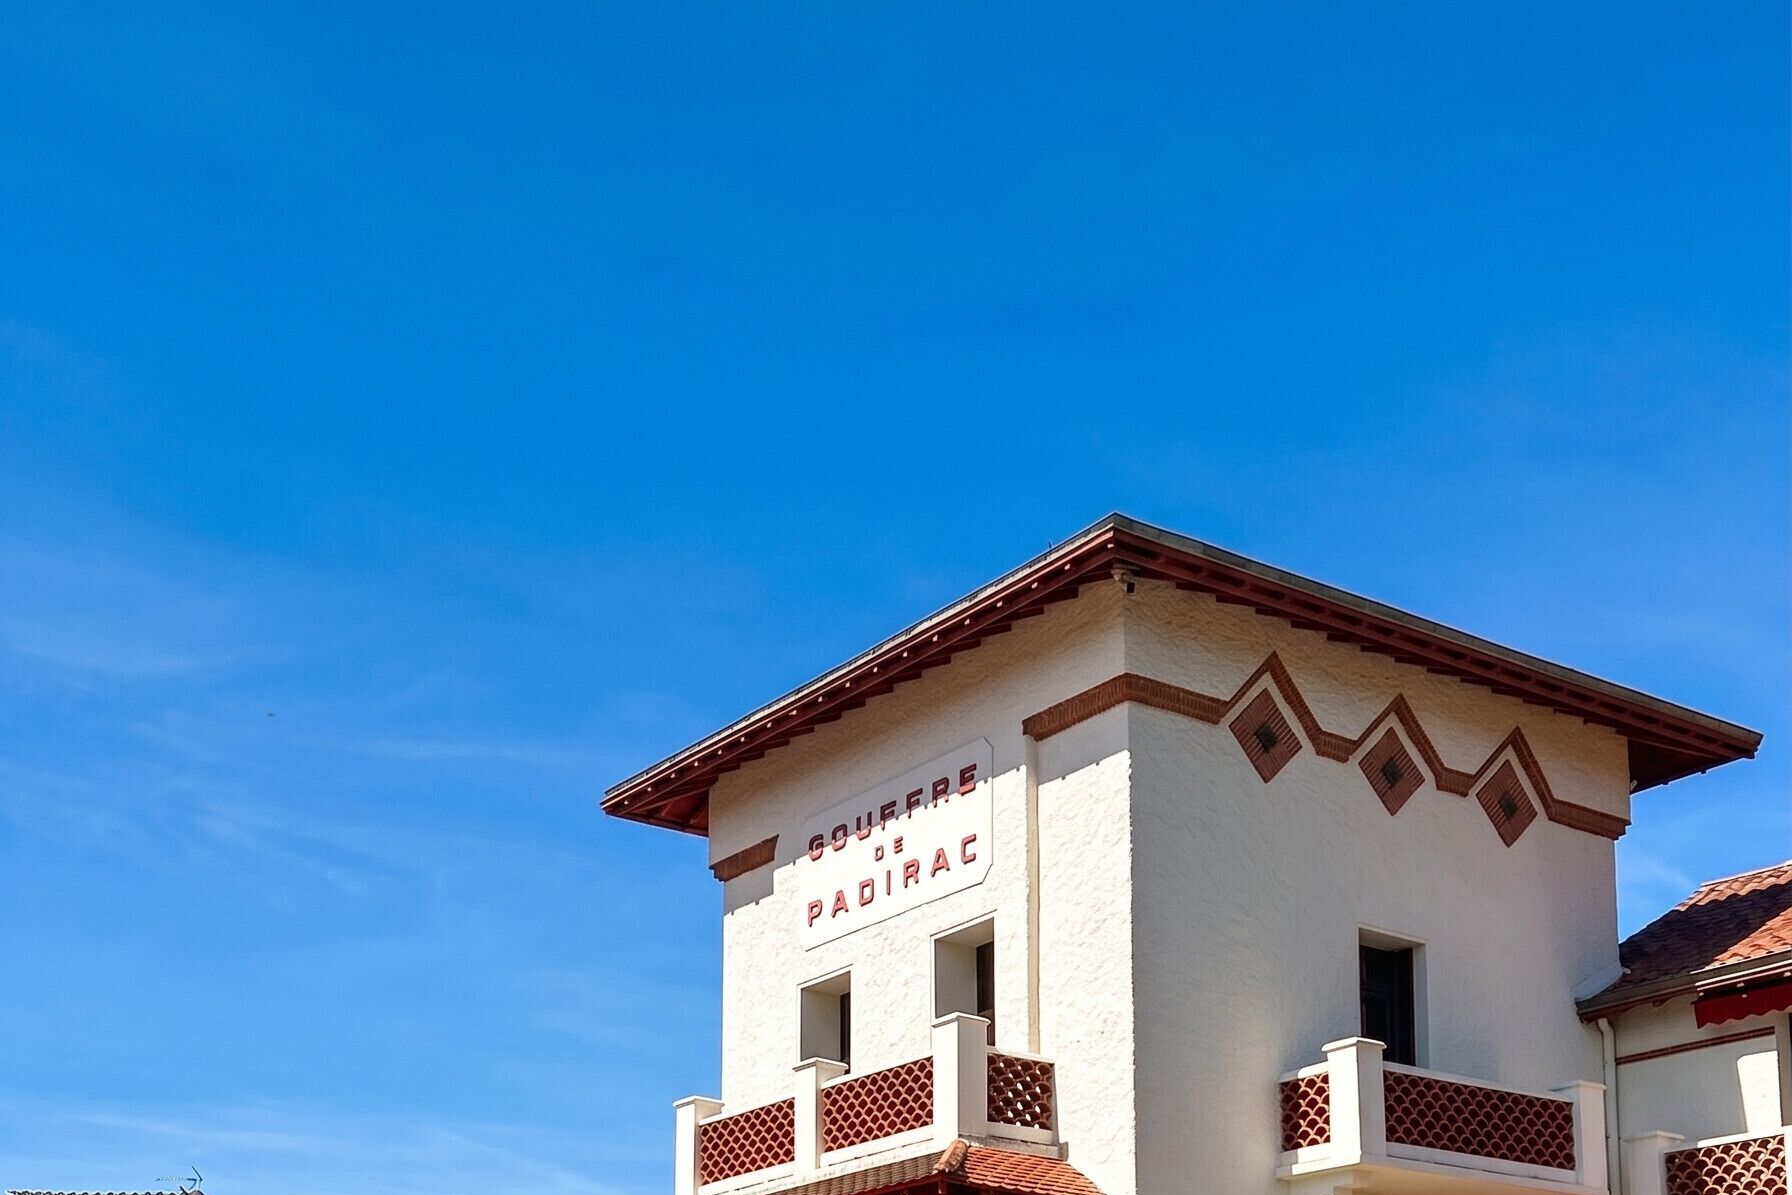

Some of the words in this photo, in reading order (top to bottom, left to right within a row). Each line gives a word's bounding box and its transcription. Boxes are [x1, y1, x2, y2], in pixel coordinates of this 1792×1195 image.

[808, 763, 977, 861] GOUFFRE
[874, 836, 904, 862] DE
[807, 833, 977, 927] PADIRAC
